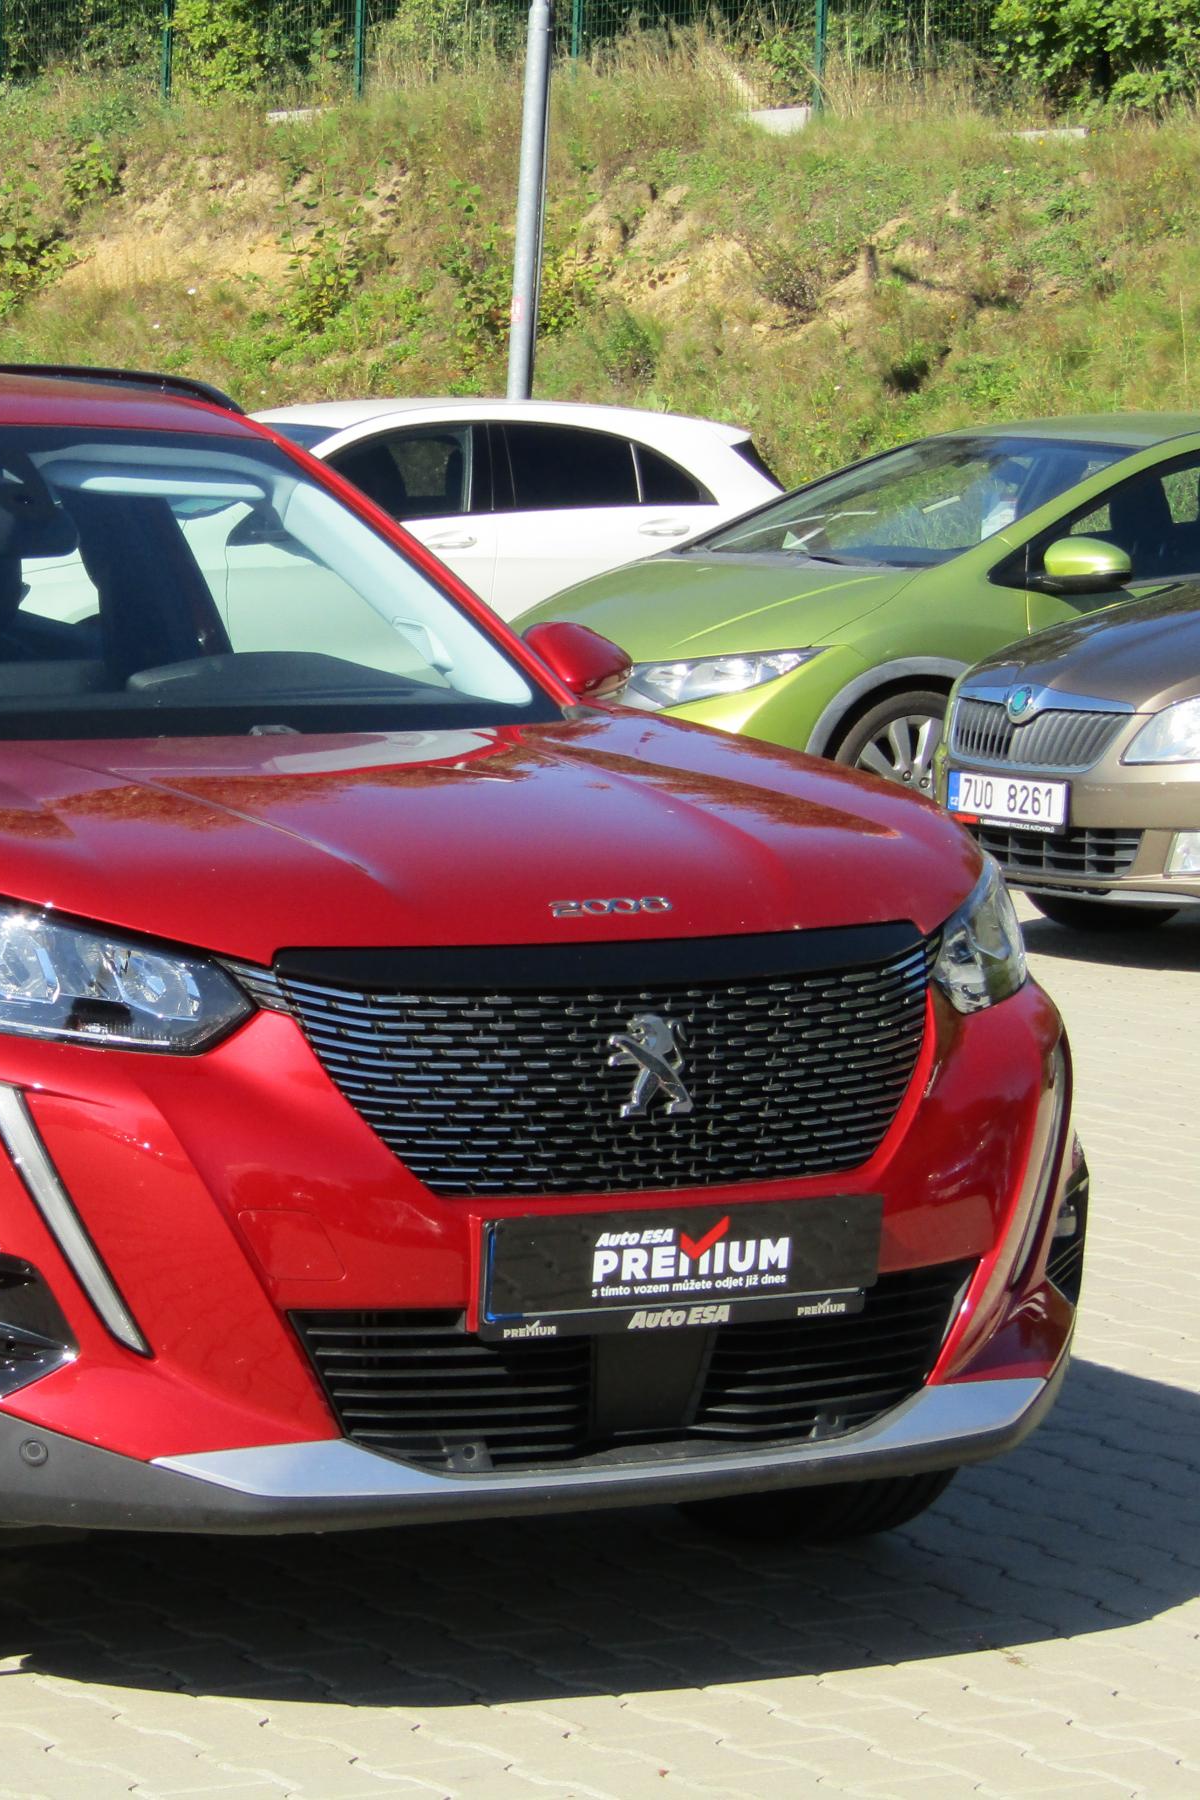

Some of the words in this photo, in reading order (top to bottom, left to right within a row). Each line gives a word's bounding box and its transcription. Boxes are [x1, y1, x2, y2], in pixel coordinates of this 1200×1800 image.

[1007, 784, 1053, 818] 8261
[595, 1231, 640, 1247] Auto
[640, 1228, 674, 1244] ESA
[592, 1234, 790, 1282] PREMIUM
[591, 1288, 598, 1298] s
[600, 1285, 631, 1297] tímto
[633, 1283, 670, 1295] vozem
[672, 1278, 712, 1292] můžete
[715, 1276, 743, 1289] odjet
[745, 1274, 759, 1288] již
[761, 1273, 787, 1285] dnes
[627, 1308, 686, 1330] Auto
[686, 1305, 731, 1325] ESA
[797, 1300, 846, 1316] PREMIUM
[503, 1321, 557, 1339] PREMIUM
